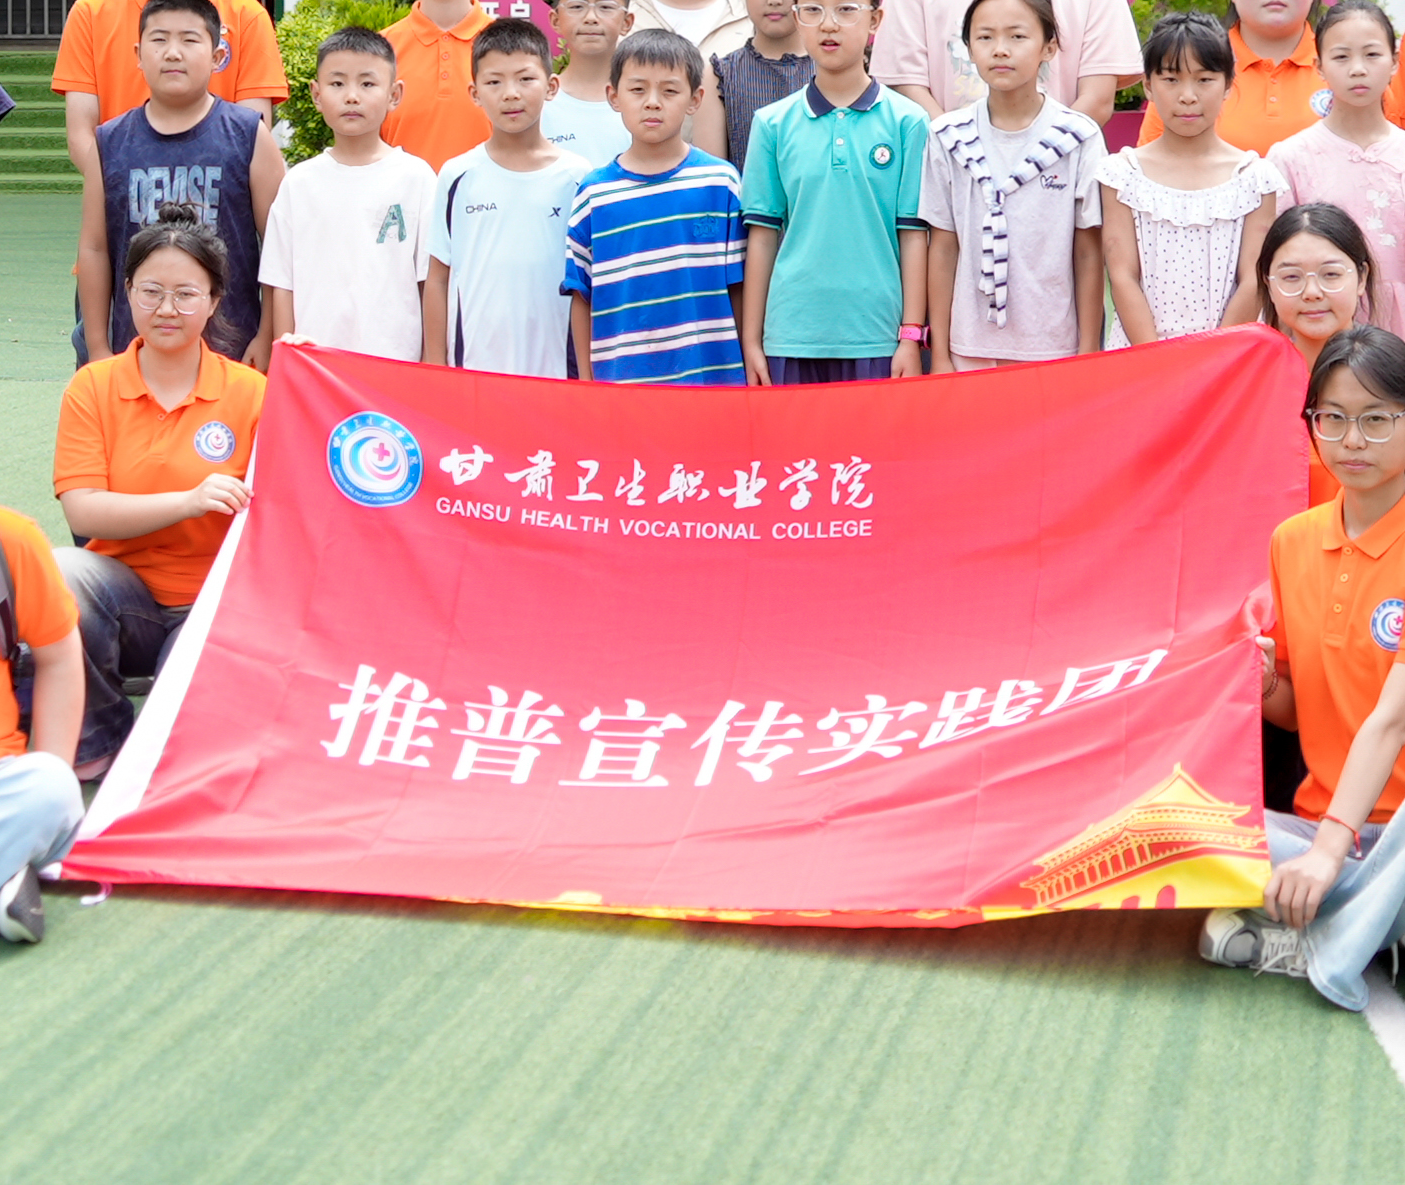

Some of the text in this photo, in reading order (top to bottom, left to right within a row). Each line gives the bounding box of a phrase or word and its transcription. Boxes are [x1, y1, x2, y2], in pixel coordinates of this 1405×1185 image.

[465, 202, 498, 214] CHINA
[439, 444, 874, 511] 甘肃卫生职业学院
[435, 496, 873, 540] GANSU HEALTH VOCATIONAL COLLEGE
[320, 648, 1168, 788] 推普宣传实践团
